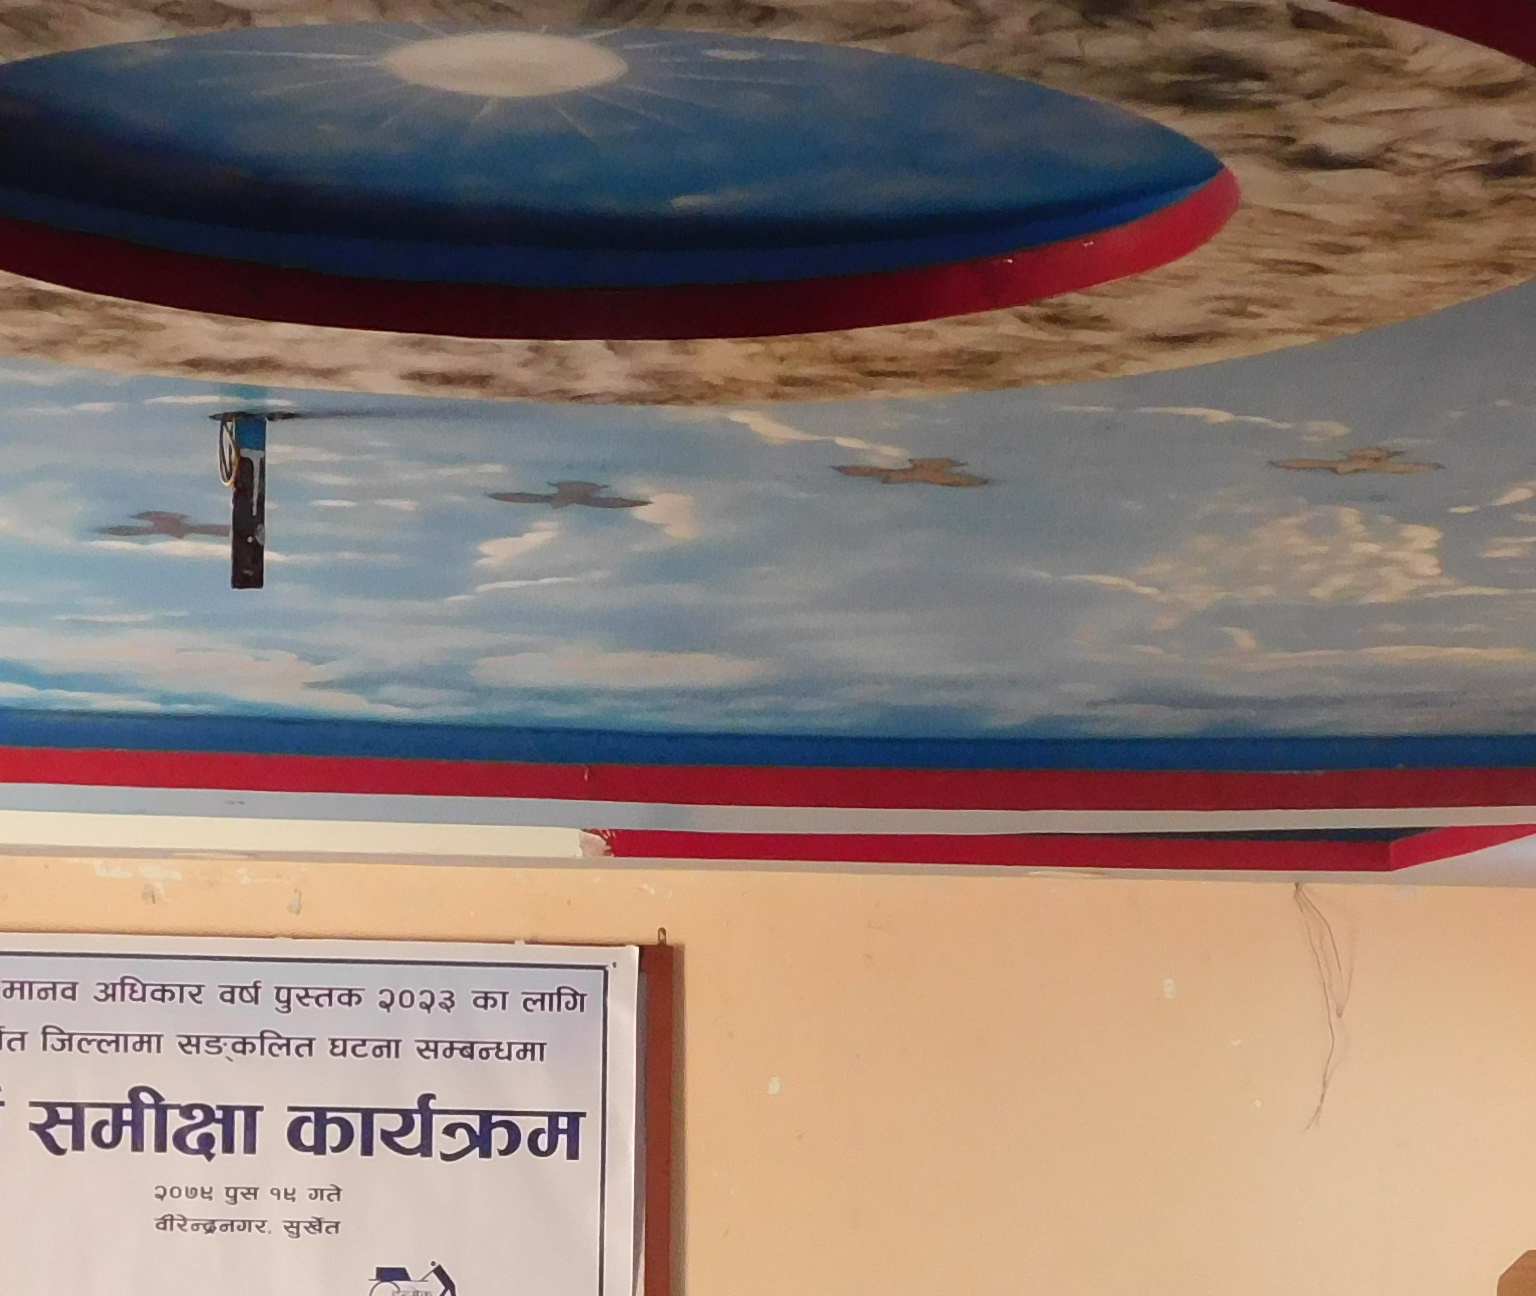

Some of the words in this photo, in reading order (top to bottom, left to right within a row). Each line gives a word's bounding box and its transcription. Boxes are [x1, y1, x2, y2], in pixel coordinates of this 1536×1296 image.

[0, 979, 80, 1002] मानव
[92, 975, 206, 1005] अधिकार
[217, 979, 263, 1006] वर्ष
[273, 985, 366, 1014] पुस्तक
[378, 988, 456, 1015] २०२३
[470, 990, 510, 1011] का
[520, 985, 589, 1013] लागि
[40, 1024, 165, 1054] जिल्लामा
[327, 1037, 403, 1059] घटना
[414, 1039, 548, 1063] सम्बन्धमा
[28, 1085, 265, 1163] समीक्षा
[286, 1092, 588, 1162] कार्यक्रम
[154, 1185, 214, 1202] २०७९
[224, 1186, 260, 1206] पुस
[269, 1187, 297, 1203] १९
[307, 1183, 343, 1203] गते
[282, 1216, 342, 1239] सुर्खेत
